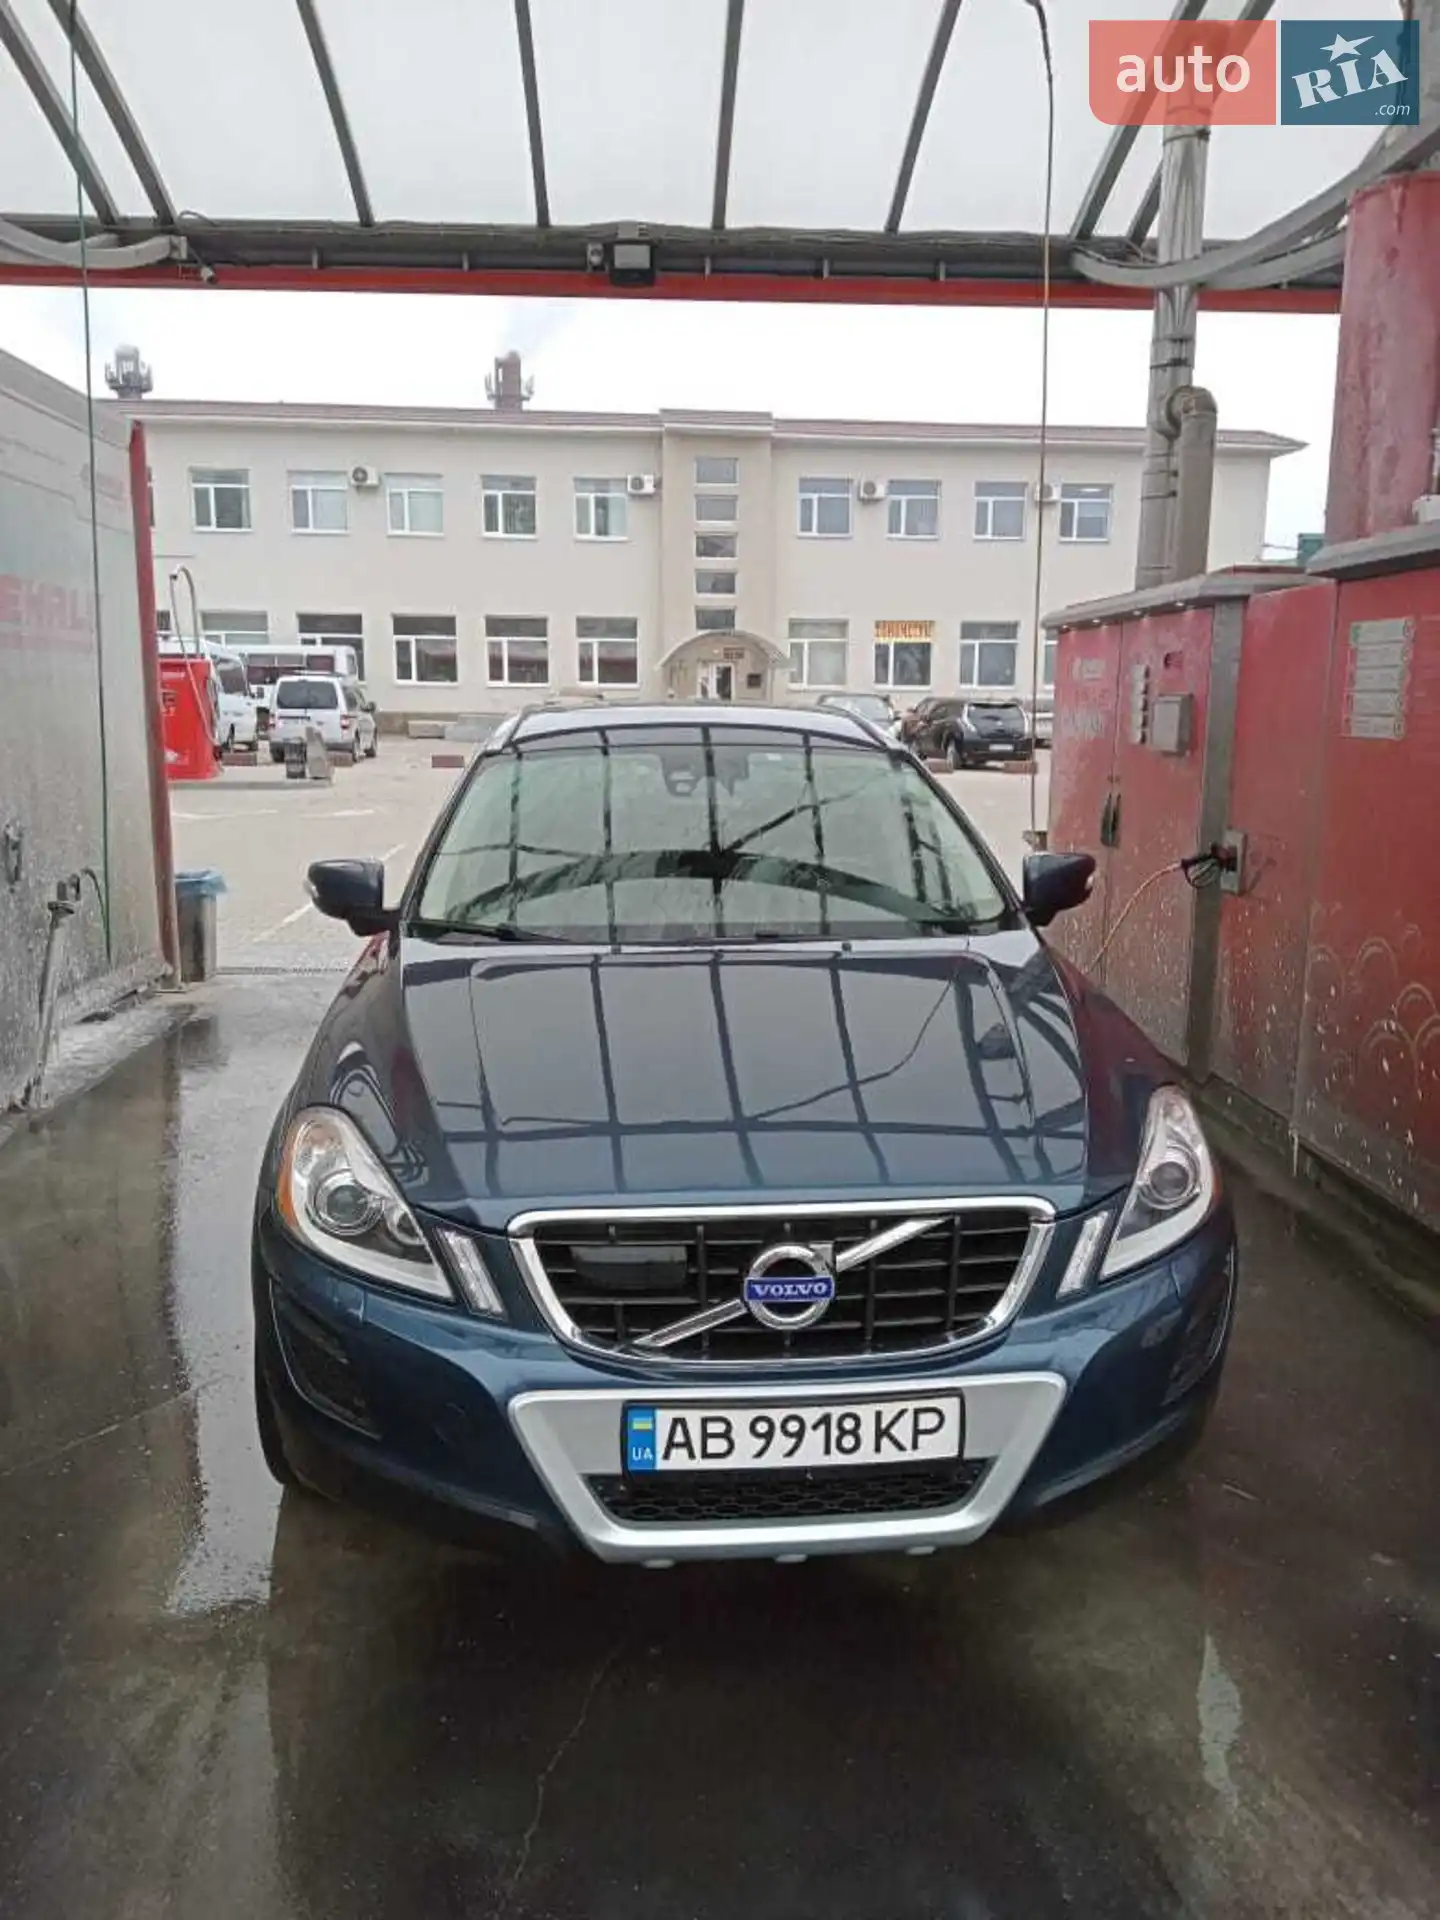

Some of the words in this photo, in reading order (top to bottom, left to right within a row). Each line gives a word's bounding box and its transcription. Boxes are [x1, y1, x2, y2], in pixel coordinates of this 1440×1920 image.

[752, 1282, 828, 1297] VOLVO
[662, 1415, 736, 1461] AB
[749, 1411, 862, 1459] 9918
[873, 1407, 946, 1454] KP
[632, 1446, 653, 1462] UA
